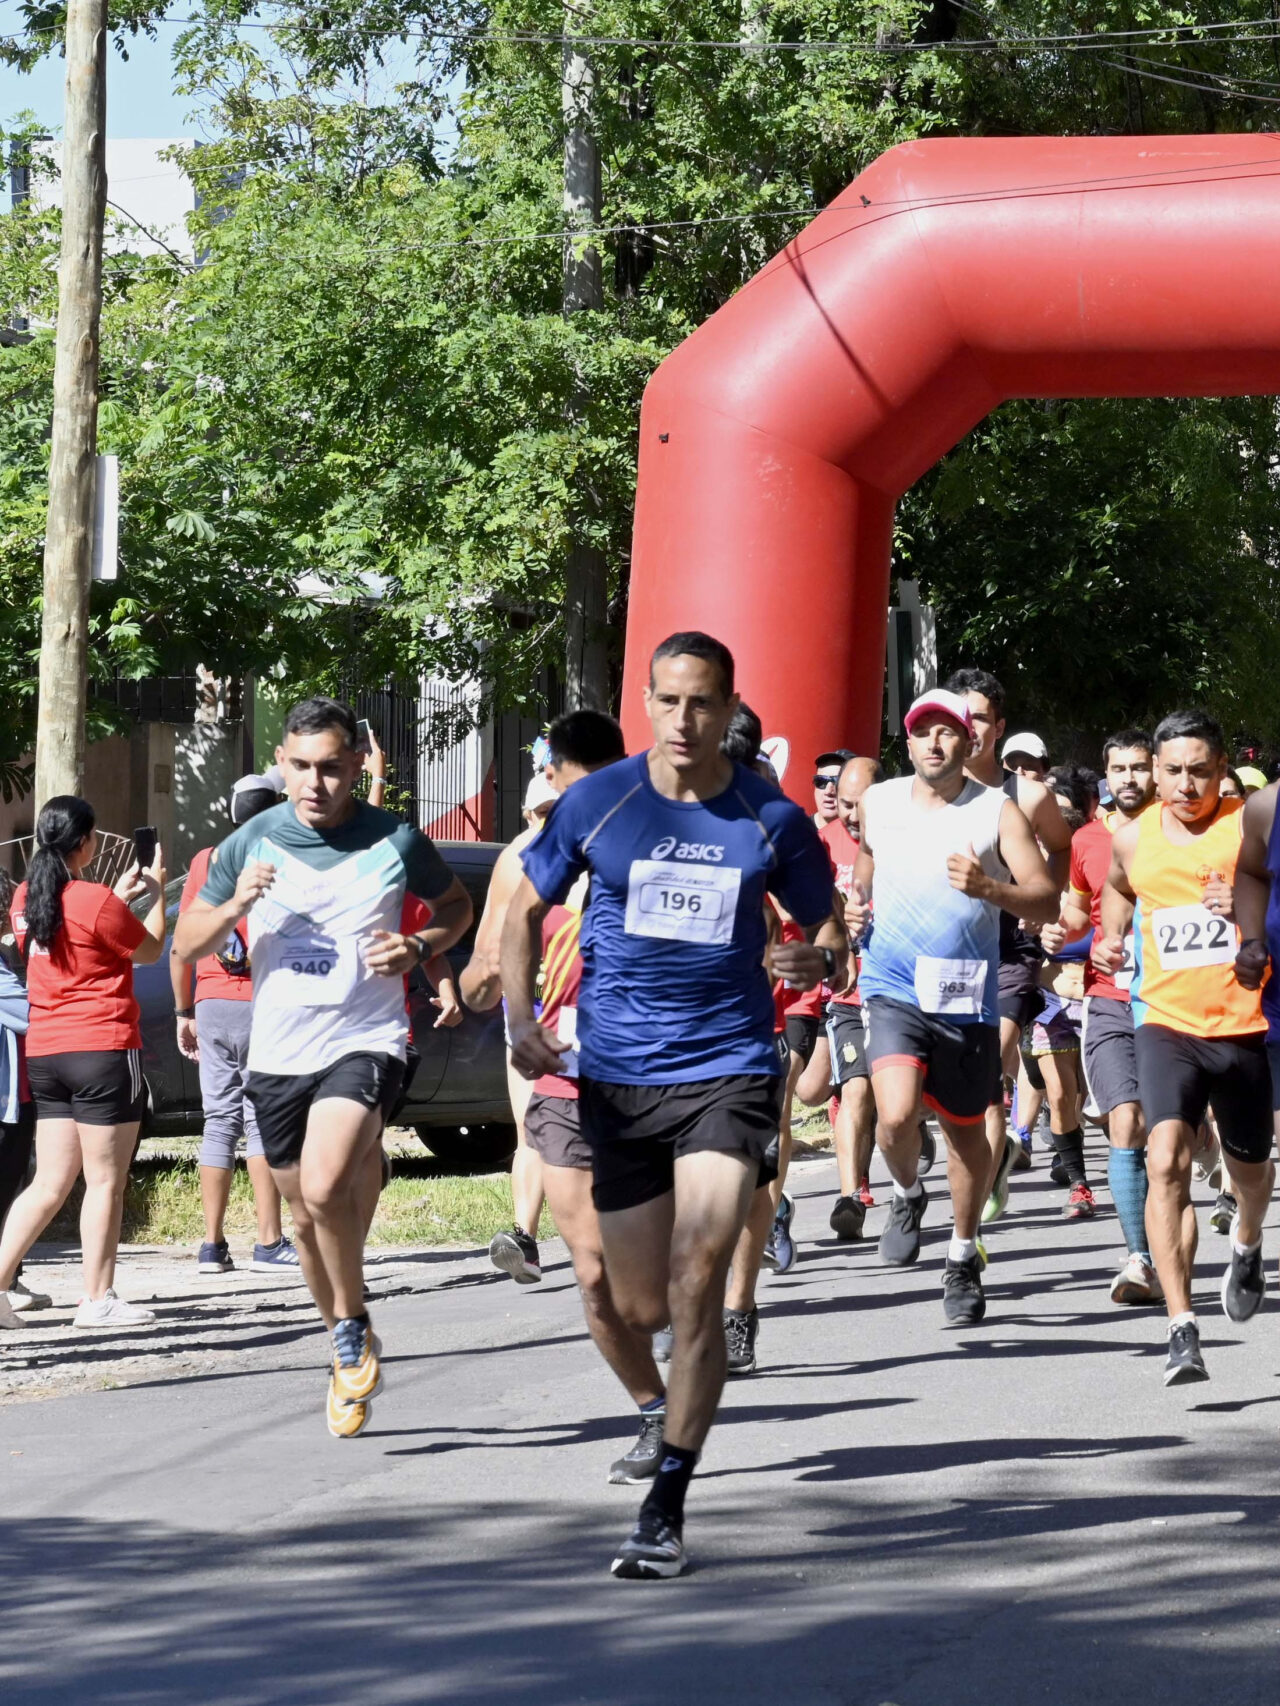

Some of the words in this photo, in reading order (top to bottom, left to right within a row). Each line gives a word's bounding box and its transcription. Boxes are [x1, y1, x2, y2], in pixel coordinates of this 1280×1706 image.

[660, 890, 702, 914] 196
[1159, 919, 1229, 954] 222
[291, 960, 331, 976] 940
[938, 981, 967, 994] 963
